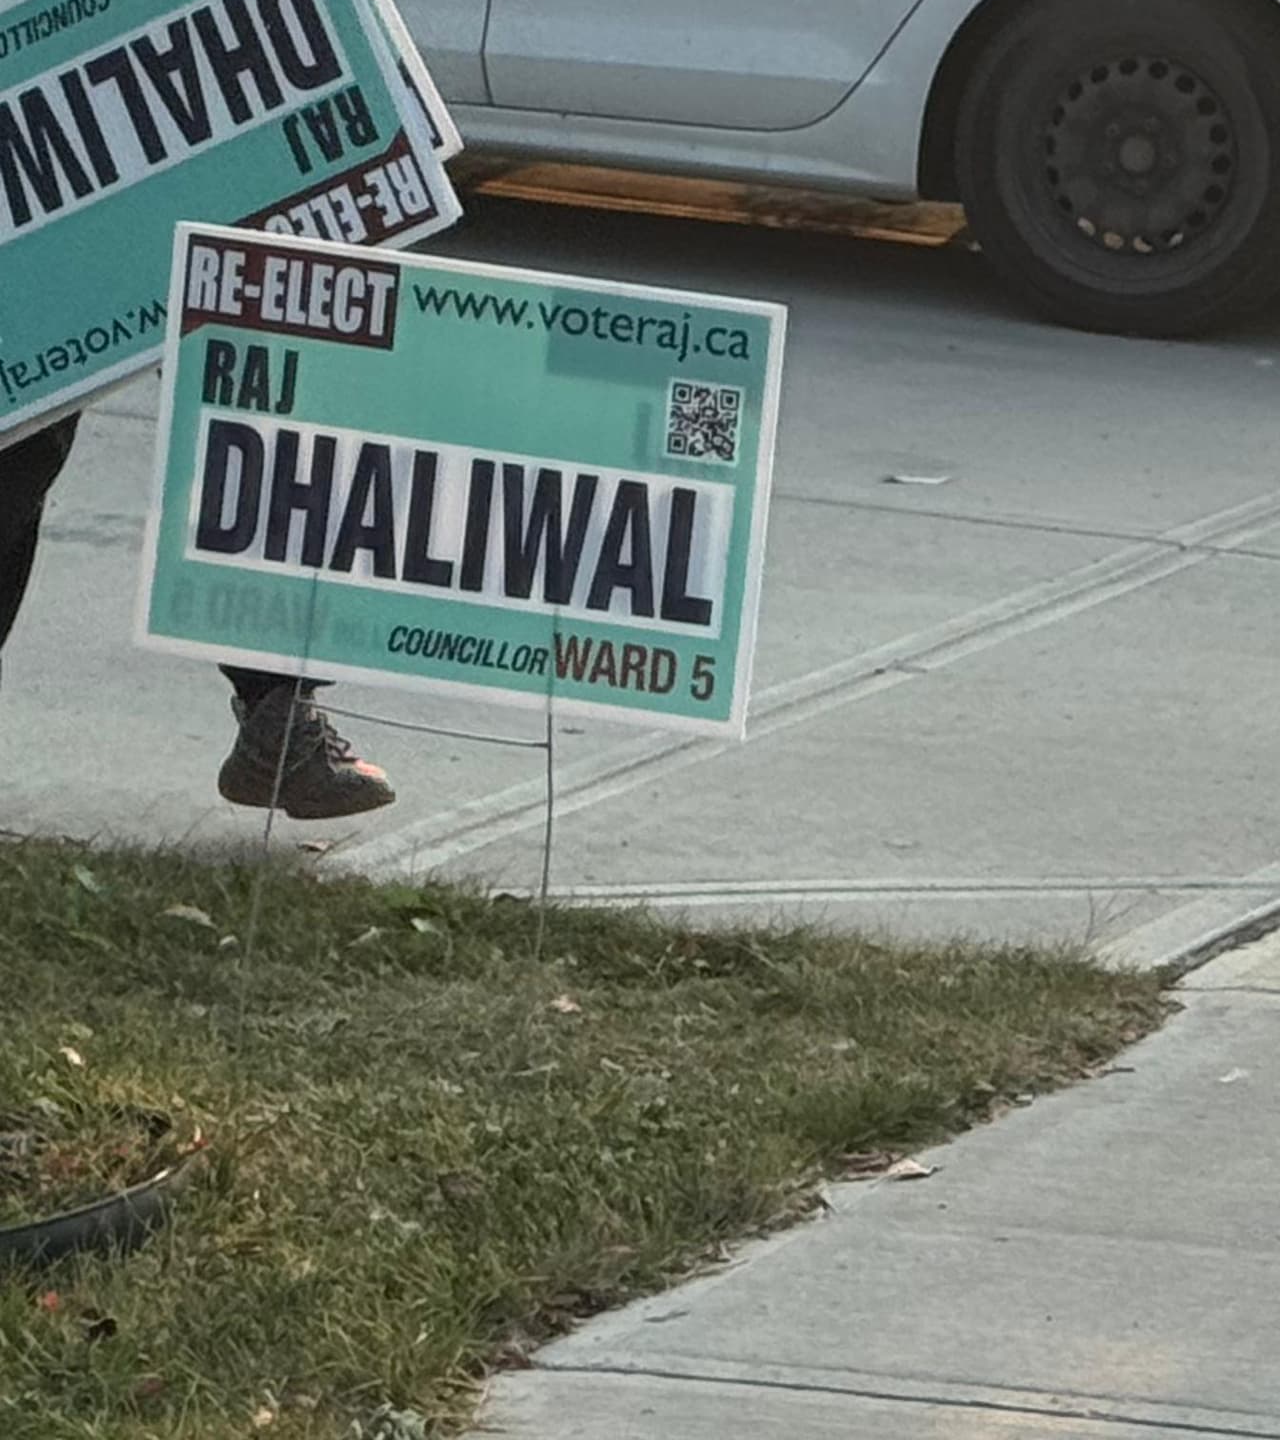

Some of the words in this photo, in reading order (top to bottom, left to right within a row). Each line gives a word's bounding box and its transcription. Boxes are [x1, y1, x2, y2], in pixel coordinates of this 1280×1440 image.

[282, 85, 380, 175] RAJ
[186, 245, 395, 337] RE-ELECT
[413, 283, 750, 363] www.voteraj.ca
[202, 338, 300, 415] RAJ
[195, 417, 714, 626] DHALIWAL
[387, 625, 549, 676] COUNCILLOR
[552, 632, 678, 694] WARD
[690, 654, 716, 701] 5
